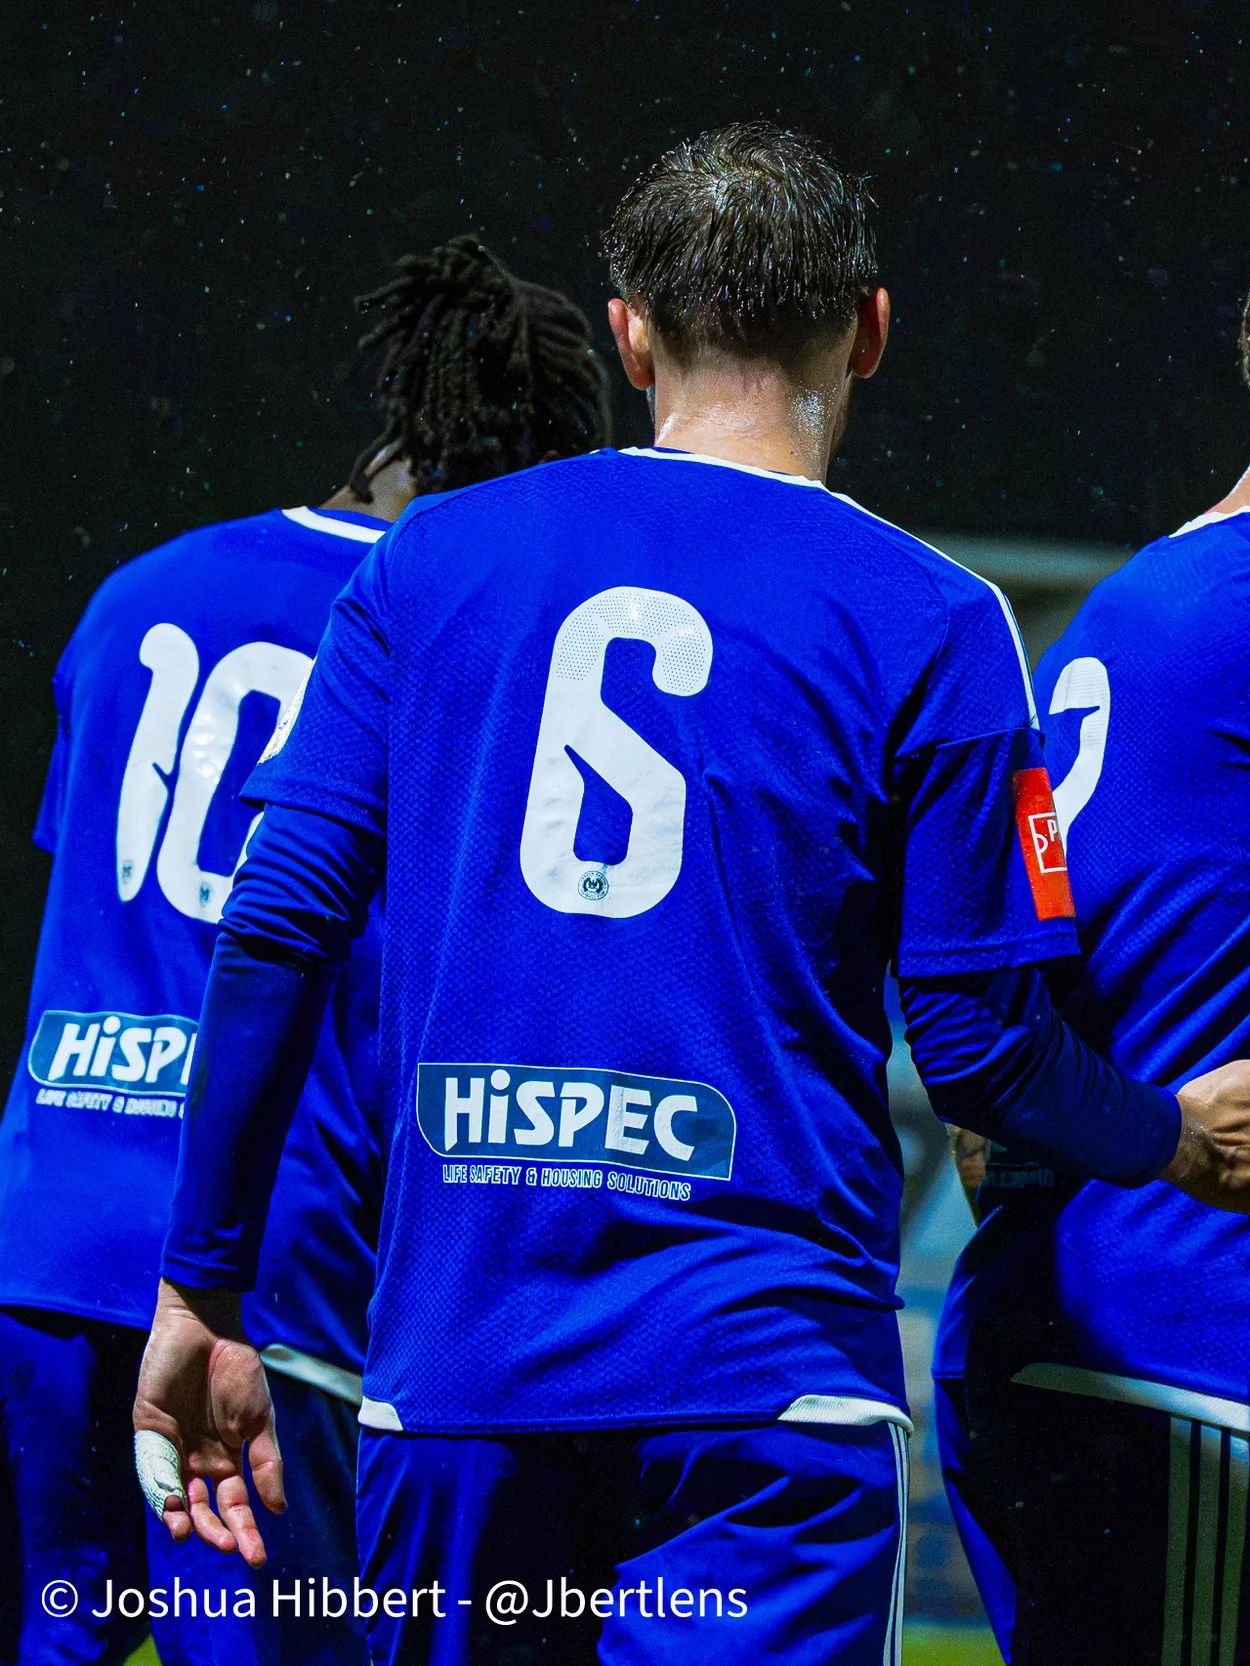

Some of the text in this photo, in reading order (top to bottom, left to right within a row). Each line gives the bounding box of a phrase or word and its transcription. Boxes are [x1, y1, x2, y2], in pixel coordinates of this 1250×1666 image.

[116, 623, 314, 924] 10
[520, 586, 713, 918] 6
[442, 1164, 691, 1201] LIFE SAFETY & HOUSING SOLUTIONS
[444, 1068, 698, 1162] HiSPEC
